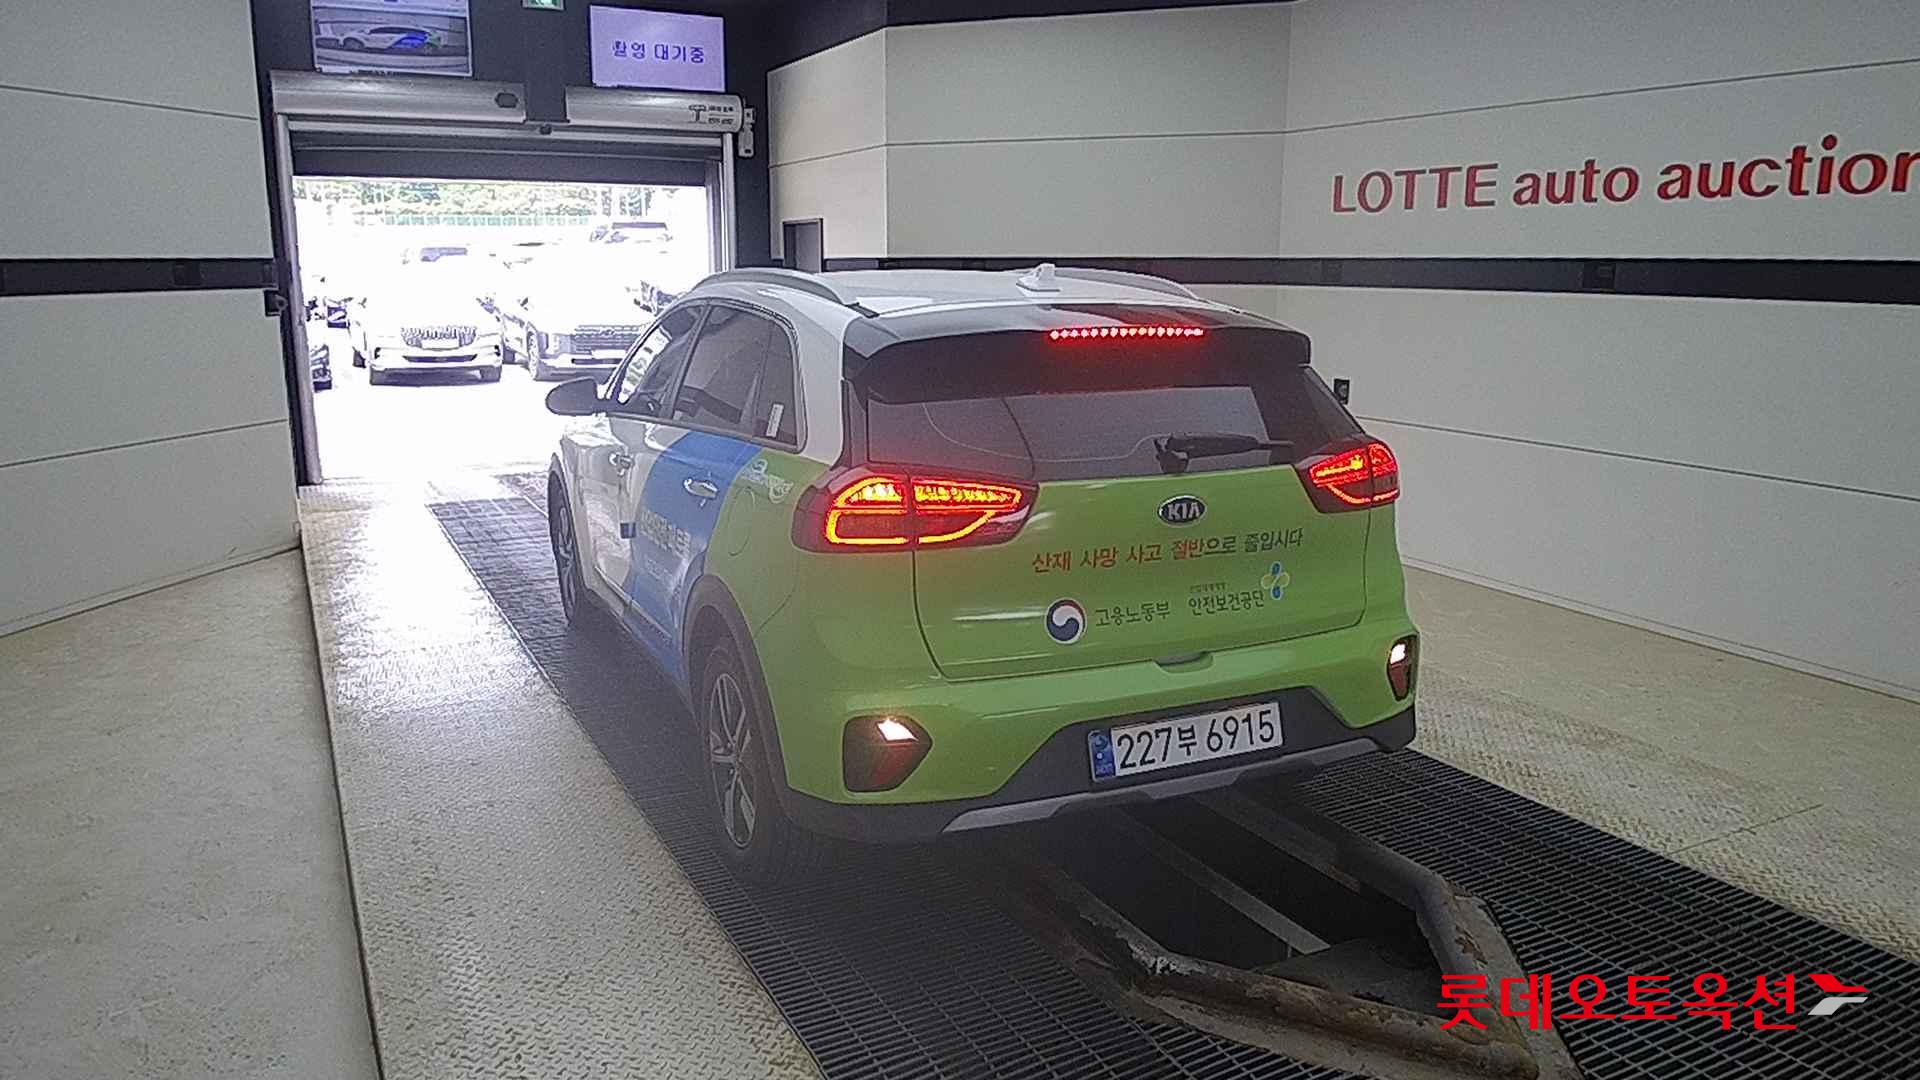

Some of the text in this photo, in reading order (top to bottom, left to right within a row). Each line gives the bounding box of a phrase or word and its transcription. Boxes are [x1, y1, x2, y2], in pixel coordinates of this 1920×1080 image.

[654, 43, 704, 63] 대기중
[1332, 162, 1499, 213] LOTTE
[1512, 158, 1638, 206] auto
[1166, 501, 1200, 520] KIA
[1032, 527, 1304, 574] 산재 사망 사고 절반으로 줄입시다
[1094, 600, 1171, 628] 고용노동부
[1188, 590, 1264, 616] 안전보건공단
[1117, 710, 1274, 769] 227부 6915
